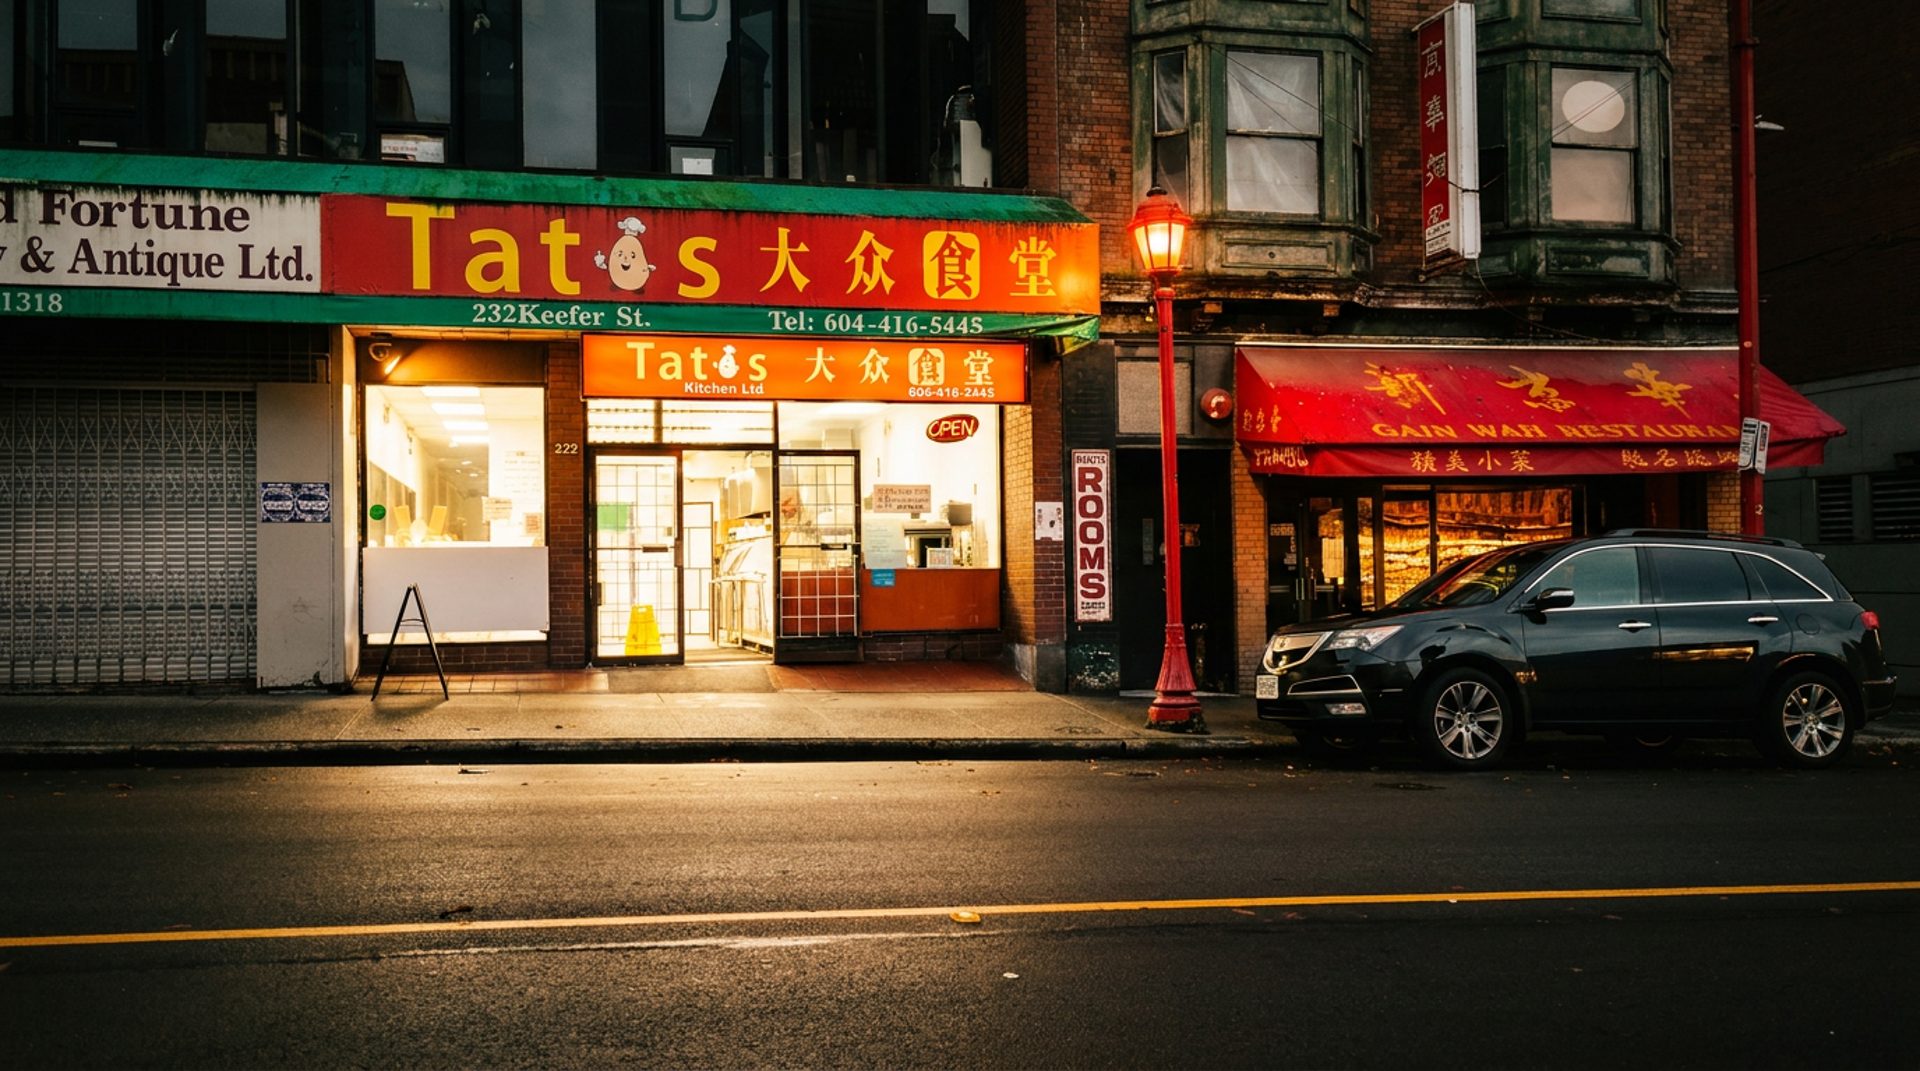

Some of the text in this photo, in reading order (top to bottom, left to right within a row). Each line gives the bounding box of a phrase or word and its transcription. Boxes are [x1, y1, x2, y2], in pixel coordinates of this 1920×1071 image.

[39, 190, 250, 232] Fortune
[20, 236, 55, 273] &
[67, 238, 224, 286] Antique
[238, 244, 313, 281] Ltd.
[759, 227, 1057, 299] 大众食堂
[2, 292, 63, 313] 1318
[616, 305, 651, 327] St.
[768, 310, 983, 334] Tel: 604-416-5445
[684, 382, 765, 395] Kitchen Ltd
[928, 419, 975, 438] OPEN
[1372, 423, 1458, 438] GAIN
[1466, 423, 1547, 438] WAH
[554, 443, 578, 454] 222
[1077, 466, 1106, 599] ROOMS
